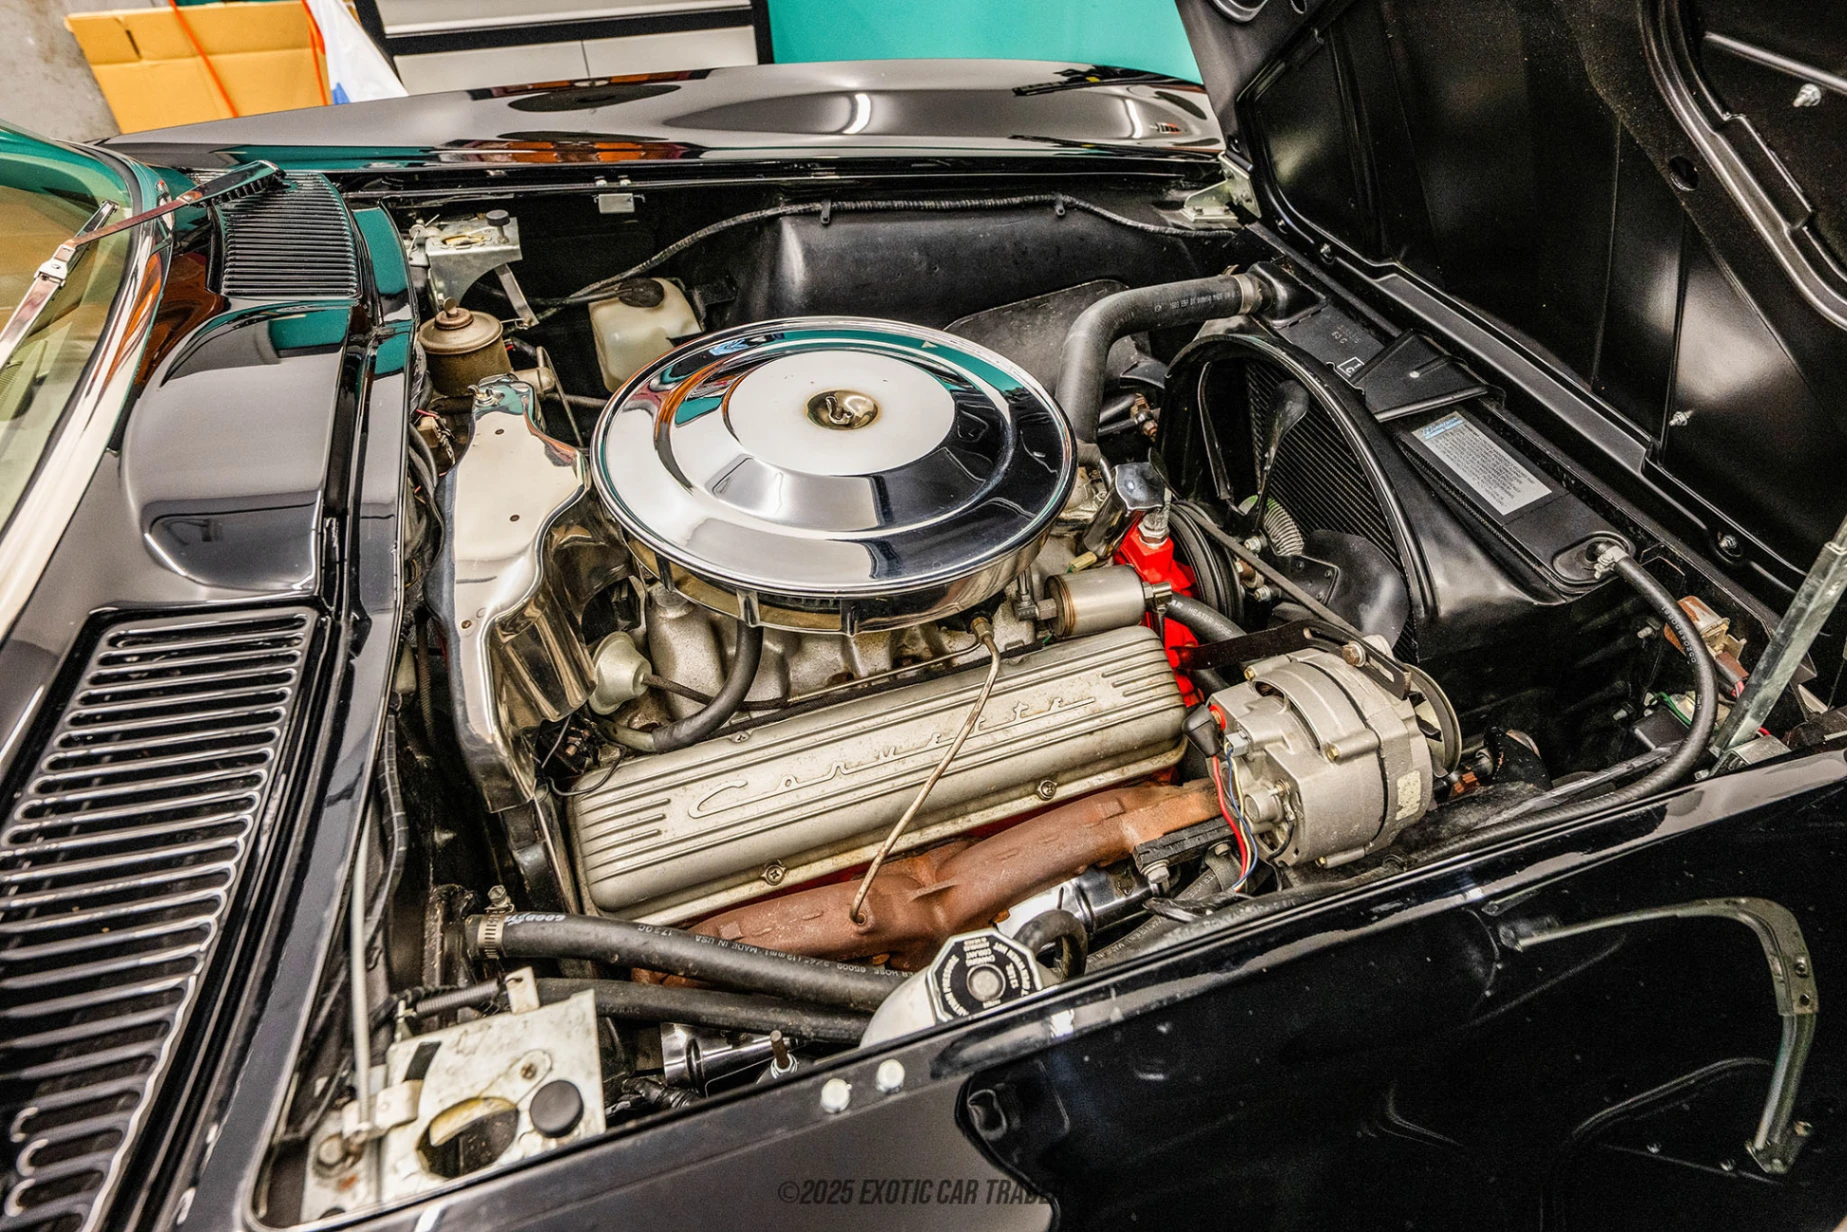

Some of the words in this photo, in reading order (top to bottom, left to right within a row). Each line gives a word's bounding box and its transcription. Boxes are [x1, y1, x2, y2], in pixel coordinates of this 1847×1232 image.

[1187, 606, 1214, 625] HEATER
[1213, 621, 1233, 637] HOSE
[694, 935, 716, 945] USA
[717, 939, 729, 948] IN
[731, 941, 759, 955] MADE
[873, 967, 899, 977] HOSE
